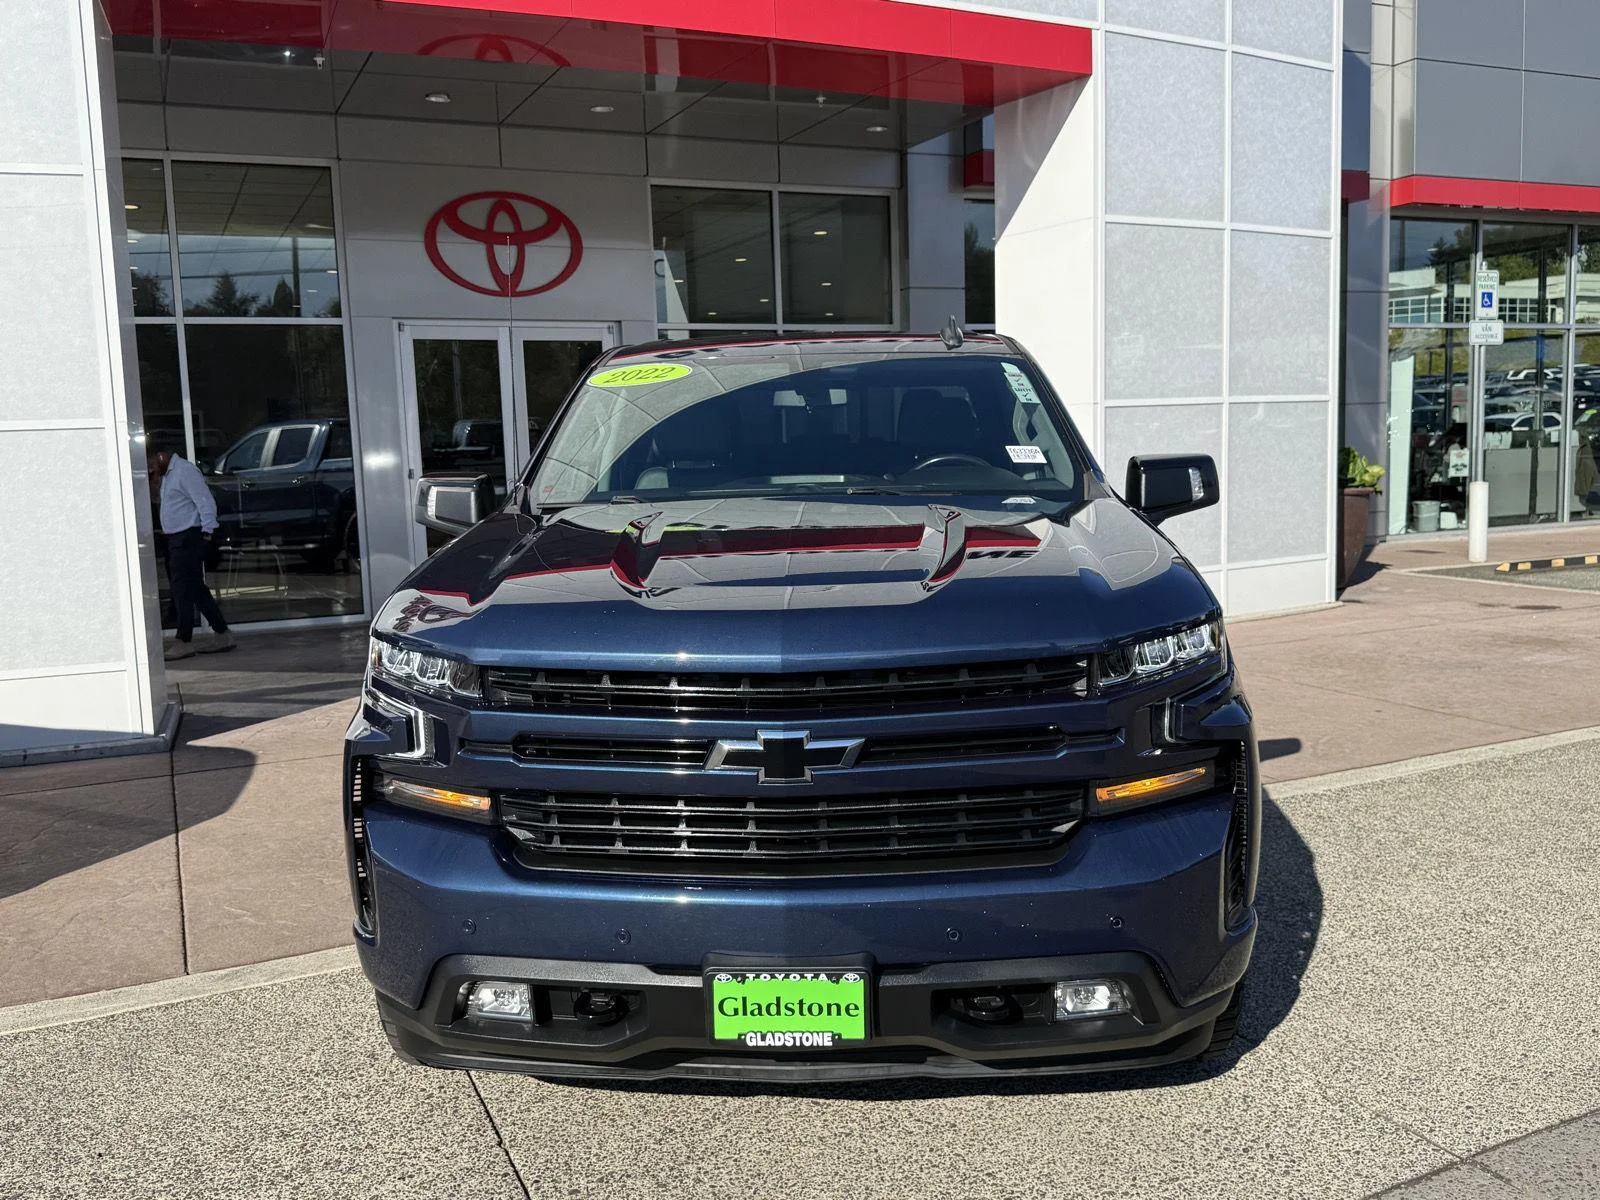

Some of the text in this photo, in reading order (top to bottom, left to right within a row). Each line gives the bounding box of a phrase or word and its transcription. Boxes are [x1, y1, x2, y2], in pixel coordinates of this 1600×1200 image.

[602, 366, 676, 384] 2022
[745, 972, 829, 981] TOYOTA
[717, 996, 860, 1018] Gladstone
[745, 1032, 833, 1047] GLADSTONE
